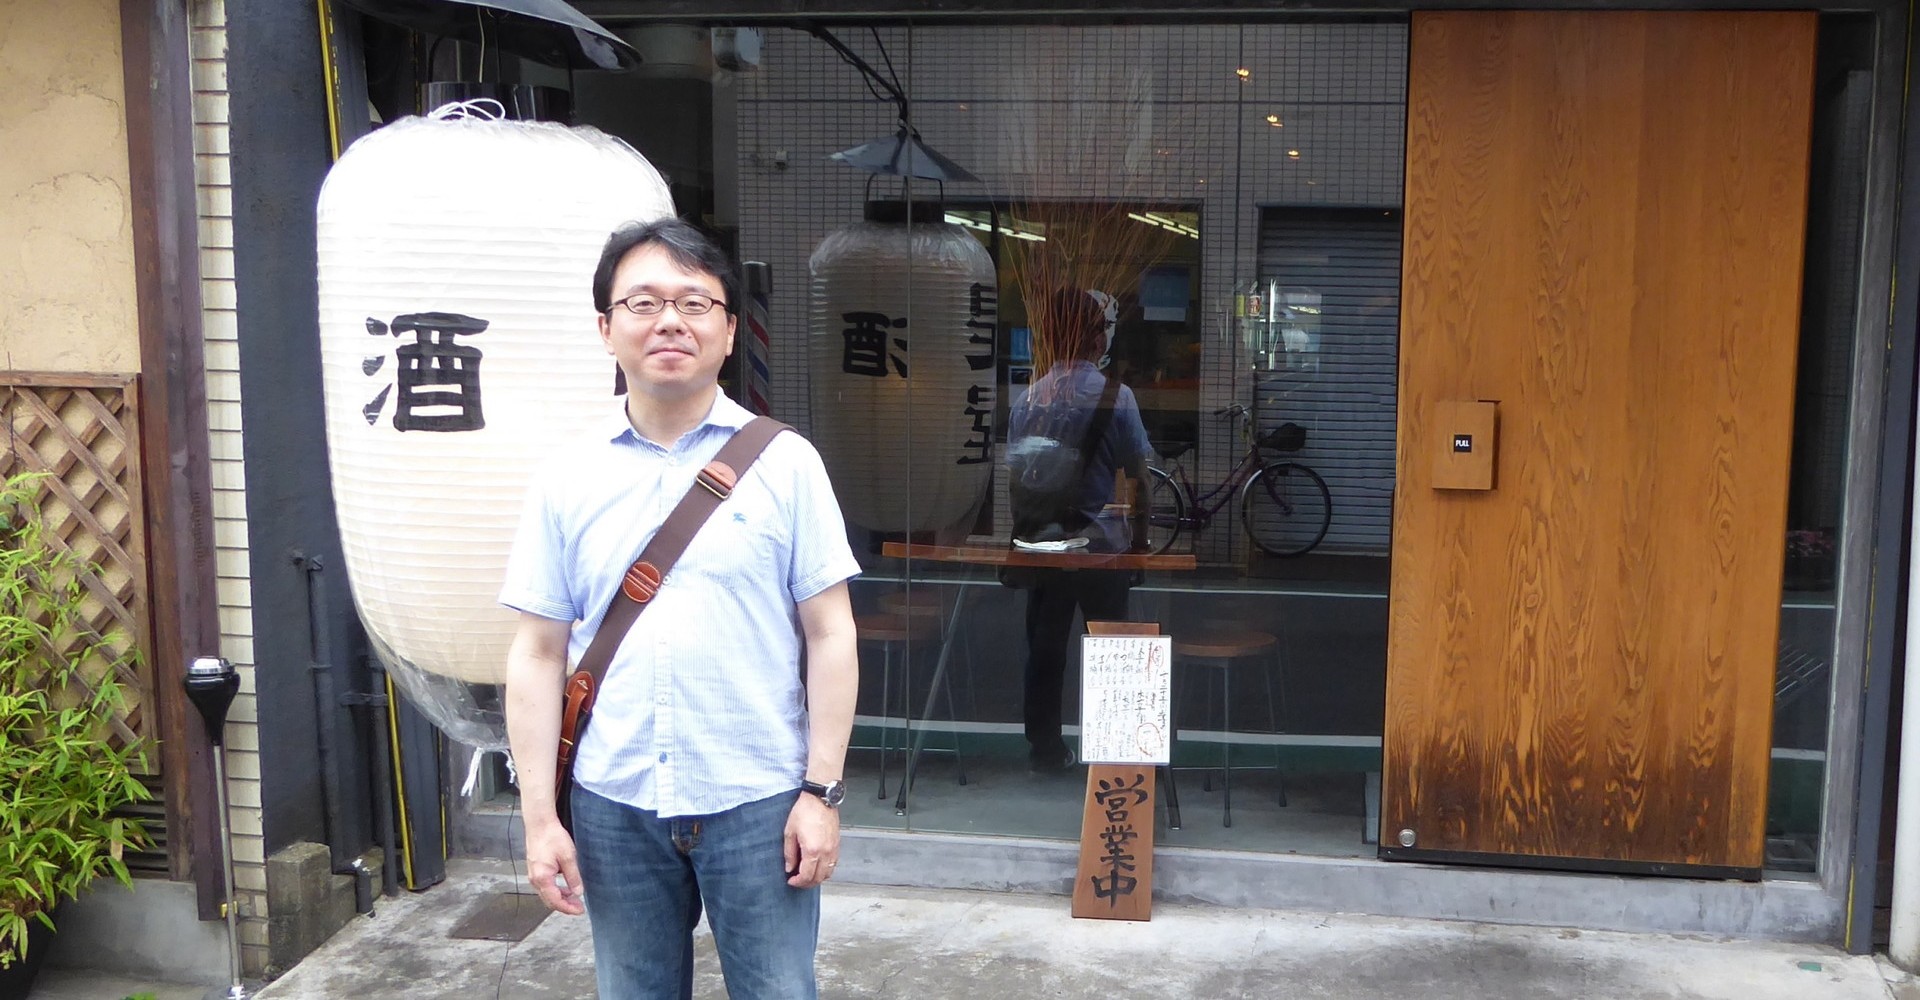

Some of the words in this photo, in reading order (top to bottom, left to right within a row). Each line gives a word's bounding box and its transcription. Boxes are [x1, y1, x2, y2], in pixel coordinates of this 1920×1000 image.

[362, 312, 490, 432] 酒
[1455, 439, 1470, 447] PULL
[1091, 773, 1148, 910] 営業中
